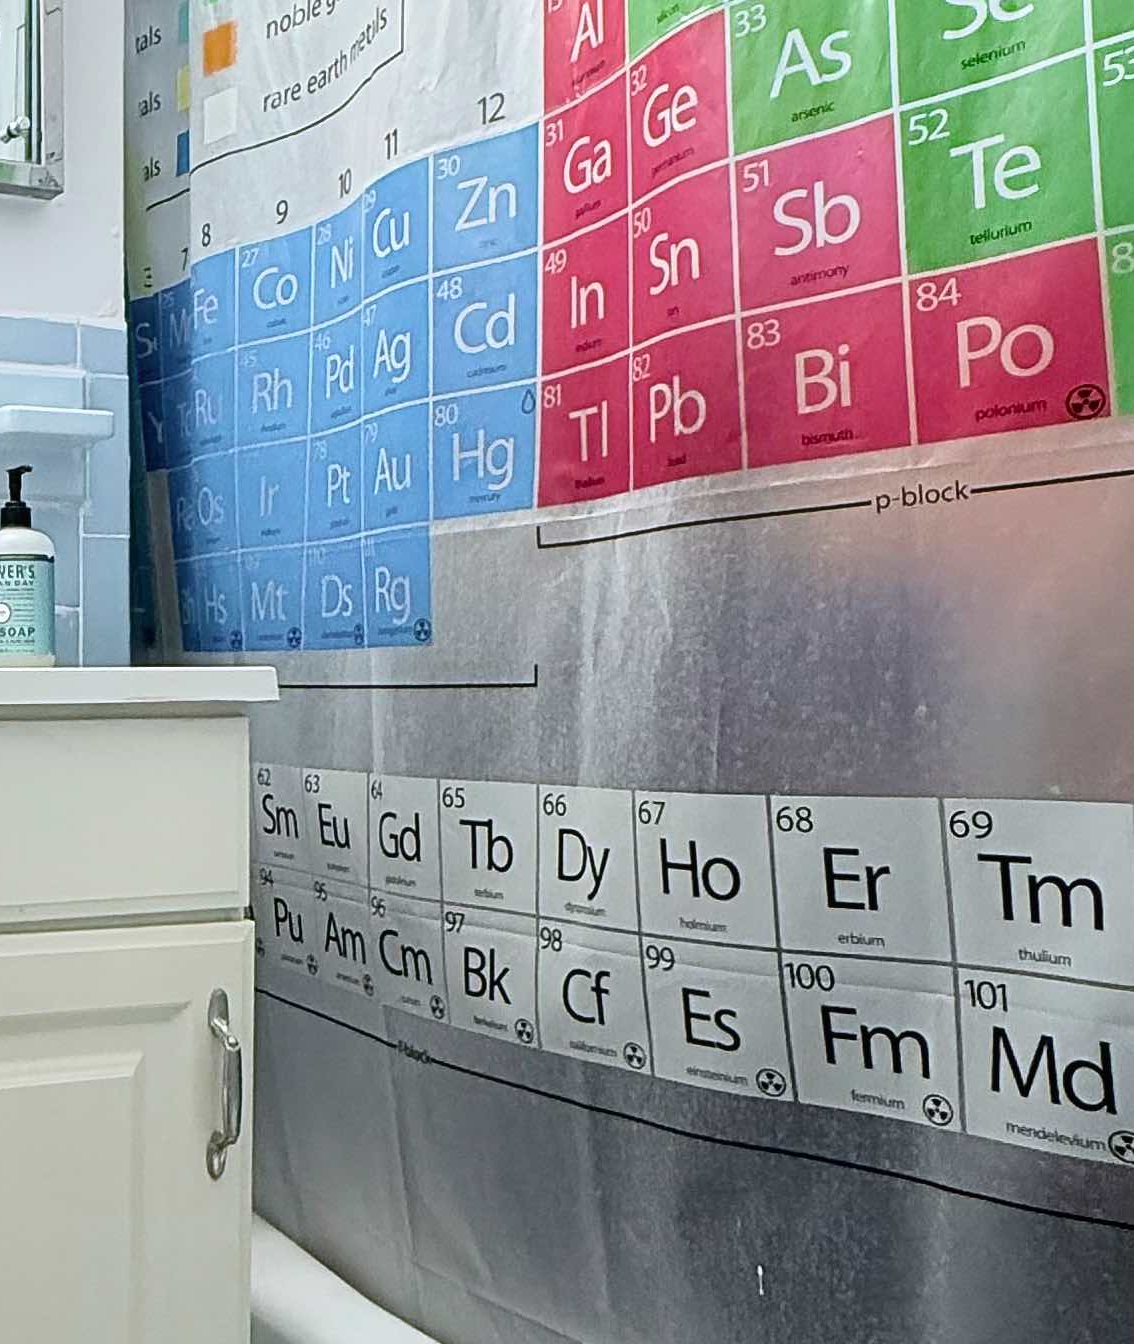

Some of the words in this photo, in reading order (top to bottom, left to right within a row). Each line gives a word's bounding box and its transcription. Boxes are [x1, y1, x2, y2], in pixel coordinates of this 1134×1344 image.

[735, 4, 767, 38] 33
[769, 27, 852, 99] As
[961, 39, 1026, 71] selenium
[263, 82, 302, 112] rare
[307, 49, 347, 94] earth
[630, 64, 647, 97] 32
[478, 92, 506, 124] 12
[642, 82, 699, 148] Ge
[791, 100, 835, 123] arsenic
[908, 108, 951, 146] 52
[384, 128, 398, 160] 11
[545, 118, 564, 148] 31
[339, 169, 352, 198] 10
[436, 154, 461, 180] 30
[563, 135, 612, 194] Ga
[743, 159, 770, 193] 51
[949, 133, 1042, 209] Te
[276, 200, 288, 224] 9
[454, 175, 516, 232] Zn
[633, 206, 652, 239] 50
[772, 180, 861, 257] Sb
[202, 223, 211, 246] 8
[372, 207, 410, 258] Cu
[969, 219, 1033, 246] tellurium
[241, 247, 259, 268] 27
[330, 236, 354, 288] Ni
[544, 249, 567, 275] 49
[648, 232, 700, 296] Sn
[790, 264, 849, 288] antimony
[253, 267, 298, 309] Co
[437, 276, 463, 301] 48
[571, 275, 605, 329] In
[916, 277, 962, 312] 84
[193, 288, 218, 330] Fe
[454, 293, 515, 354] Cd
[315, 330, 331, 351] 46
[747, 319, 781, 350] 83
[956, 316, 1054, 389] Po
[326, 344, 354, 399] Pd
[373, 328, 411, 383] Ag
[632, 353, 651, 382] 82
[251, 367, 292, 414] Rh
[543, 383, 562, 408] 81
[794, 343, 851, 415] Bi
[194, 389, 220, 428] Ru
[434, 403, 458, 427] 80
[649, 374, 707, 443] Pb
[975, 398, 1047, 422] polonium
[569, 400, 608, 462] Tl
[801, 428, 854, 447] bismuth
[374, 447, 411, 496] Au
[452, 428, 515, 490] Hg
[259, 475, 280, 518] Ir
[327, 463, 351, 508] Pt
[875, 480, 970, 513] p-block
[197, 486, 225, 526] Os
[204, 584, 228, 625] Hs
[251, 581, 289, 622] Mt
[321, 574, 353, 617] Ds
[375, 566, 411, 625] Rg
[0, 627, 36, 637] SOAP
[257, 768, 271, 786] 62
[304, 774, 320, 793] 63
[371, 779, 383, 800] 64
[262, 793, 299, 838] Sm
[442, 786, 466, 808] 65
[542, 793, 567, 816] 66
[637, 800, 666, 825] 67
[318, 803, 351, 849] Eu
[379, 811, 421, 862] Gd
[776, 806, 814, 833] 68
[949, 810, 993, 839] 69
[459, 818, 513, 873] Tb
[557, 828, 610, 901] Dy
[659, 837, 741, 901] Ho
[823, 847, 890, 911] Er
[371, 895, 386, 918] 96
[977, 853, 1105, 931] Tm
[273, 897, 304, 944] Pu
[324, 912, 366, 965] Am
[445, 911, 465, 933] 97
[540, 927, 563, 952] 98
[837, 931, 885, 948] erbium
[379, 929, 433, 985] Cm
[464, 947, 511, 1005] Bk
[645, 945, 675, 971] 99
[1018, 947, 1072, 967] thulium
[562, 968, 610, 1025] Cf
[783, 963, 835, 992] 100
[964, 978, 1008, 1012] 101
[681, 987, 742, 1053] Es
[820, 1005, 931, 1080] Fm
[991, 1026, 1118, 1116] Md
[851, 1088, 905, 1110] fermium
[1005, 1121, 1107, 1153] mendelevium
